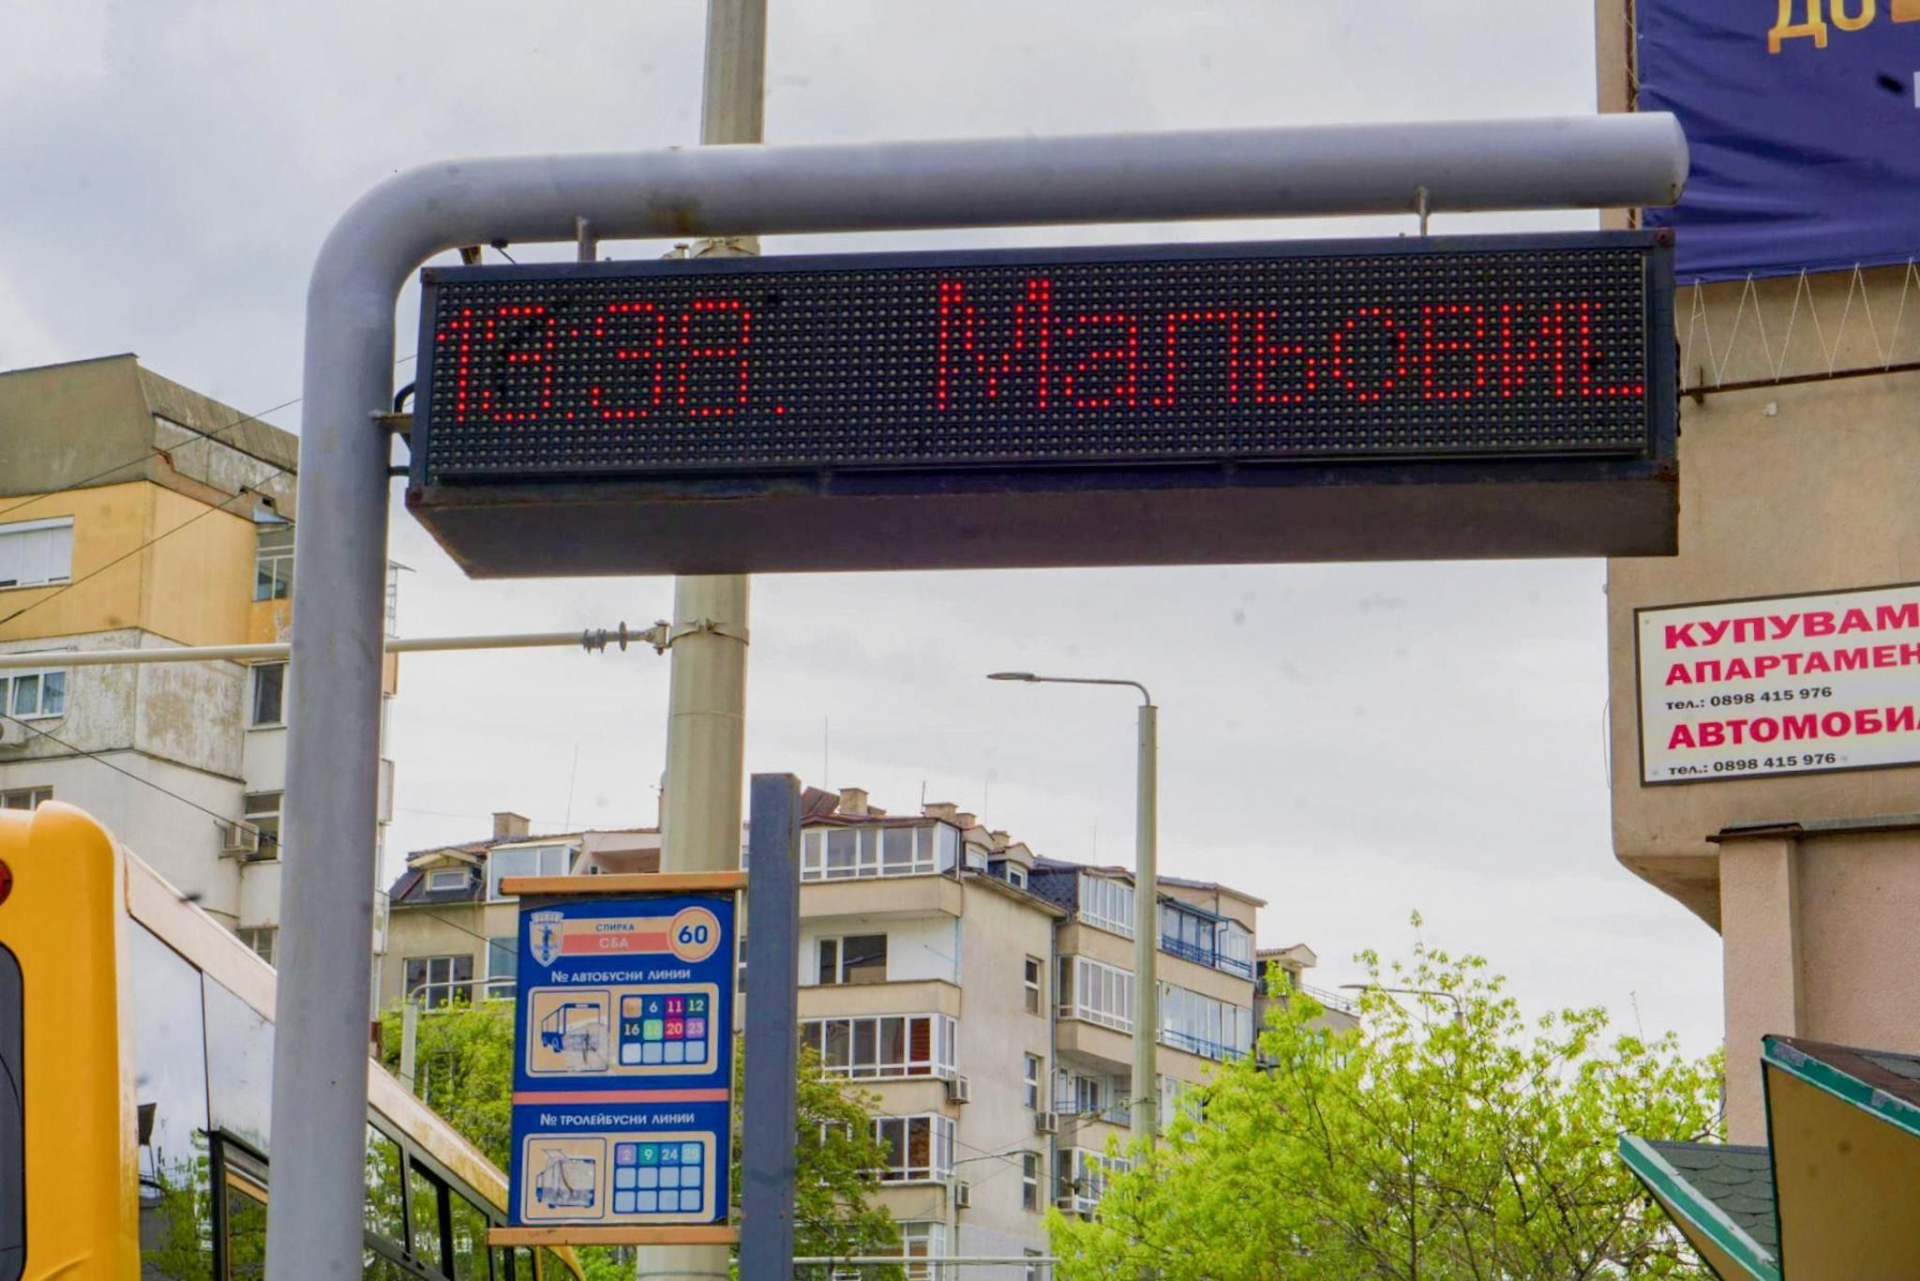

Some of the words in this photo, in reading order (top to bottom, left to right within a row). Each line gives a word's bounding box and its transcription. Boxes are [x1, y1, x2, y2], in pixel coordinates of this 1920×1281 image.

[1664, 602, 1920, 650] КУПУВАМ
[1710, 692, 1756, 707] 0898
[1760, 690, 1794, 702] 415
[1799, 686, 1833, 699] 976
[1667, 705, 1920, 750] АВТОМОБИ
[1713, 759, 1759, 773] 0898
[1763, 755, 1798, 769] 415
[1802, 752, 1837, 766] 976
[595, 923, 635, 932] СПИРКА
[677, 925, 709, 945] 60
[598, 937, 629, 950] СБА
[571, 970, 643, 984] АВТОБУСНИ
[647, 968, 691, 981] ЛИНИИ
[649, 1000, 659, 1014] 6
[667, 1000, 683, 1014] 11
[688, 998, 705, 1012] 12
[623, 1023, 640, 1037] 16
[666, 1022, 684, 1035] 20
[560, 1113, 647, 1126] ТРОЛЕЙБУСНИ
[651, 1113, 695, 1125] ЛИНИИ
[644, 1148, 654, 1161] 9
[661, 1148, 679, 1160] 24
